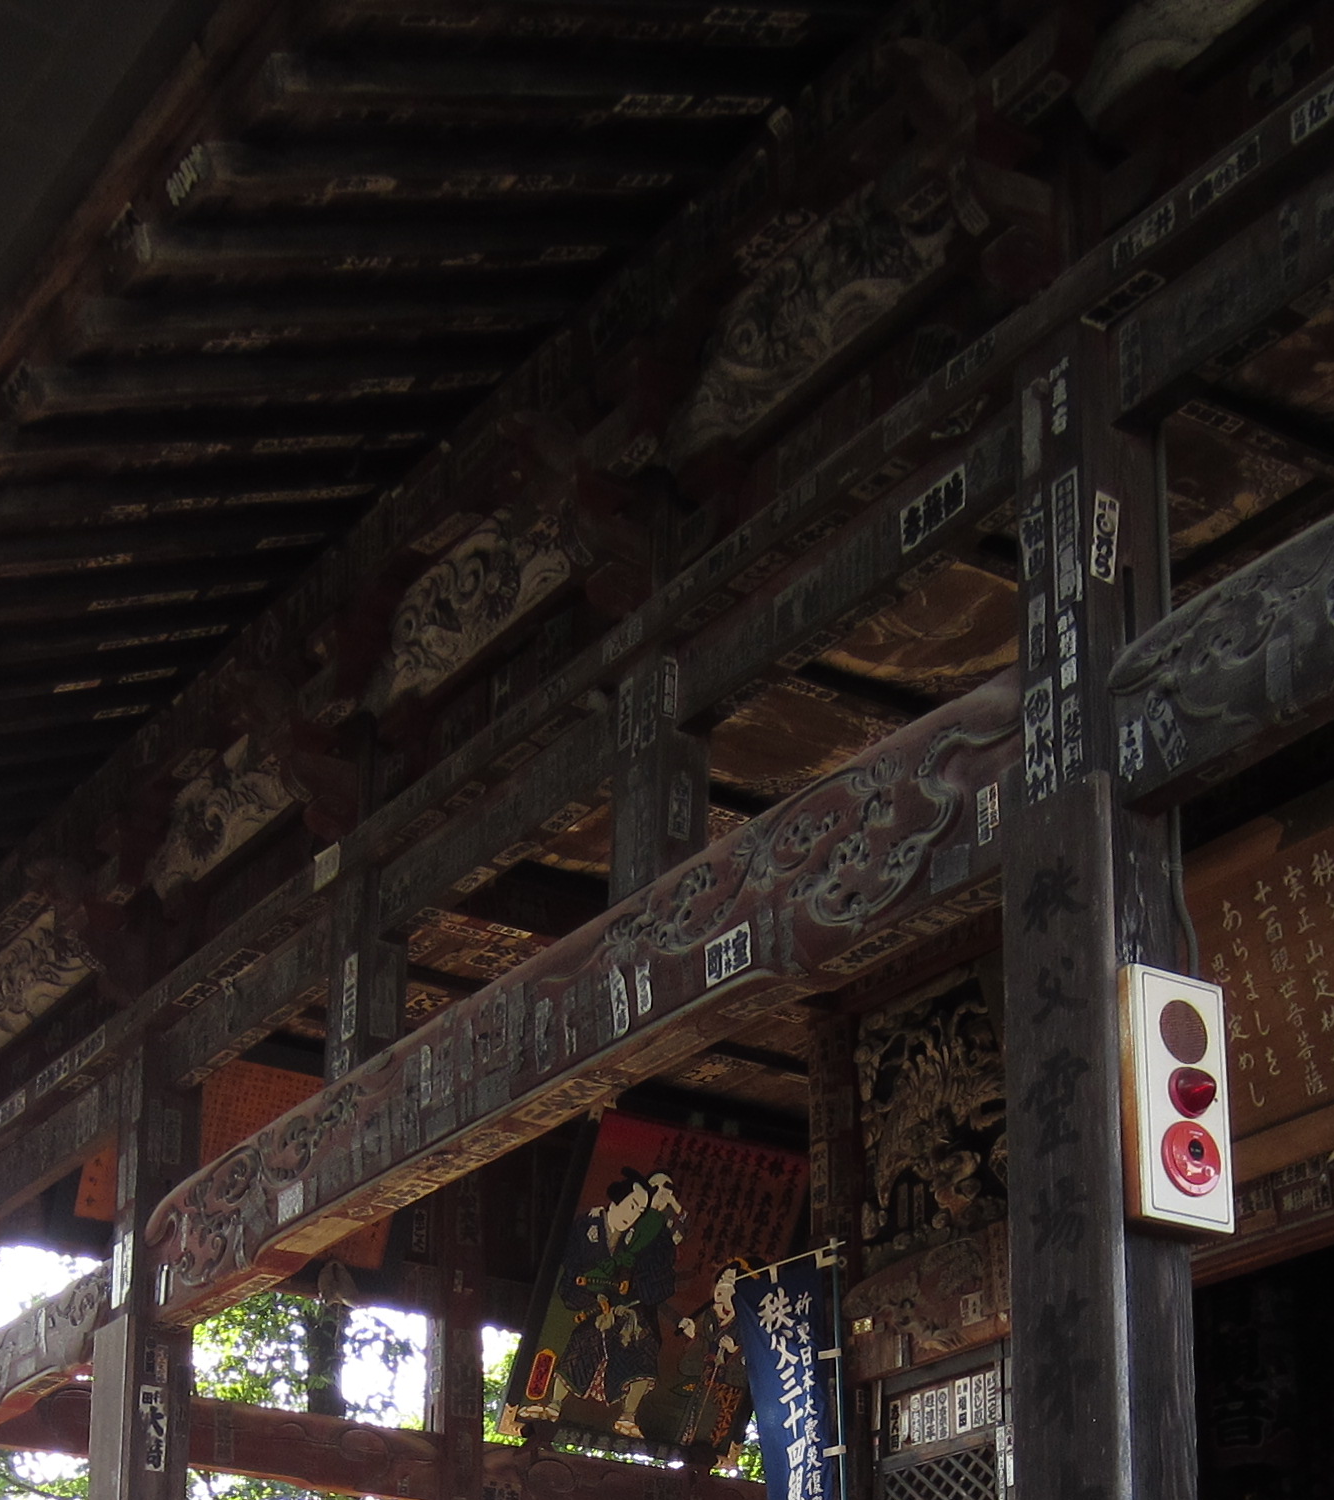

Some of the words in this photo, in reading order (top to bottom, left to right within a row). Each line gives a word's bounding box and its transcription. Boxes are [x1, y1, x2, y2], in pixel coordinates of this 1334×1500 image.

[1221, 899, 1282, 1076] あらましを
